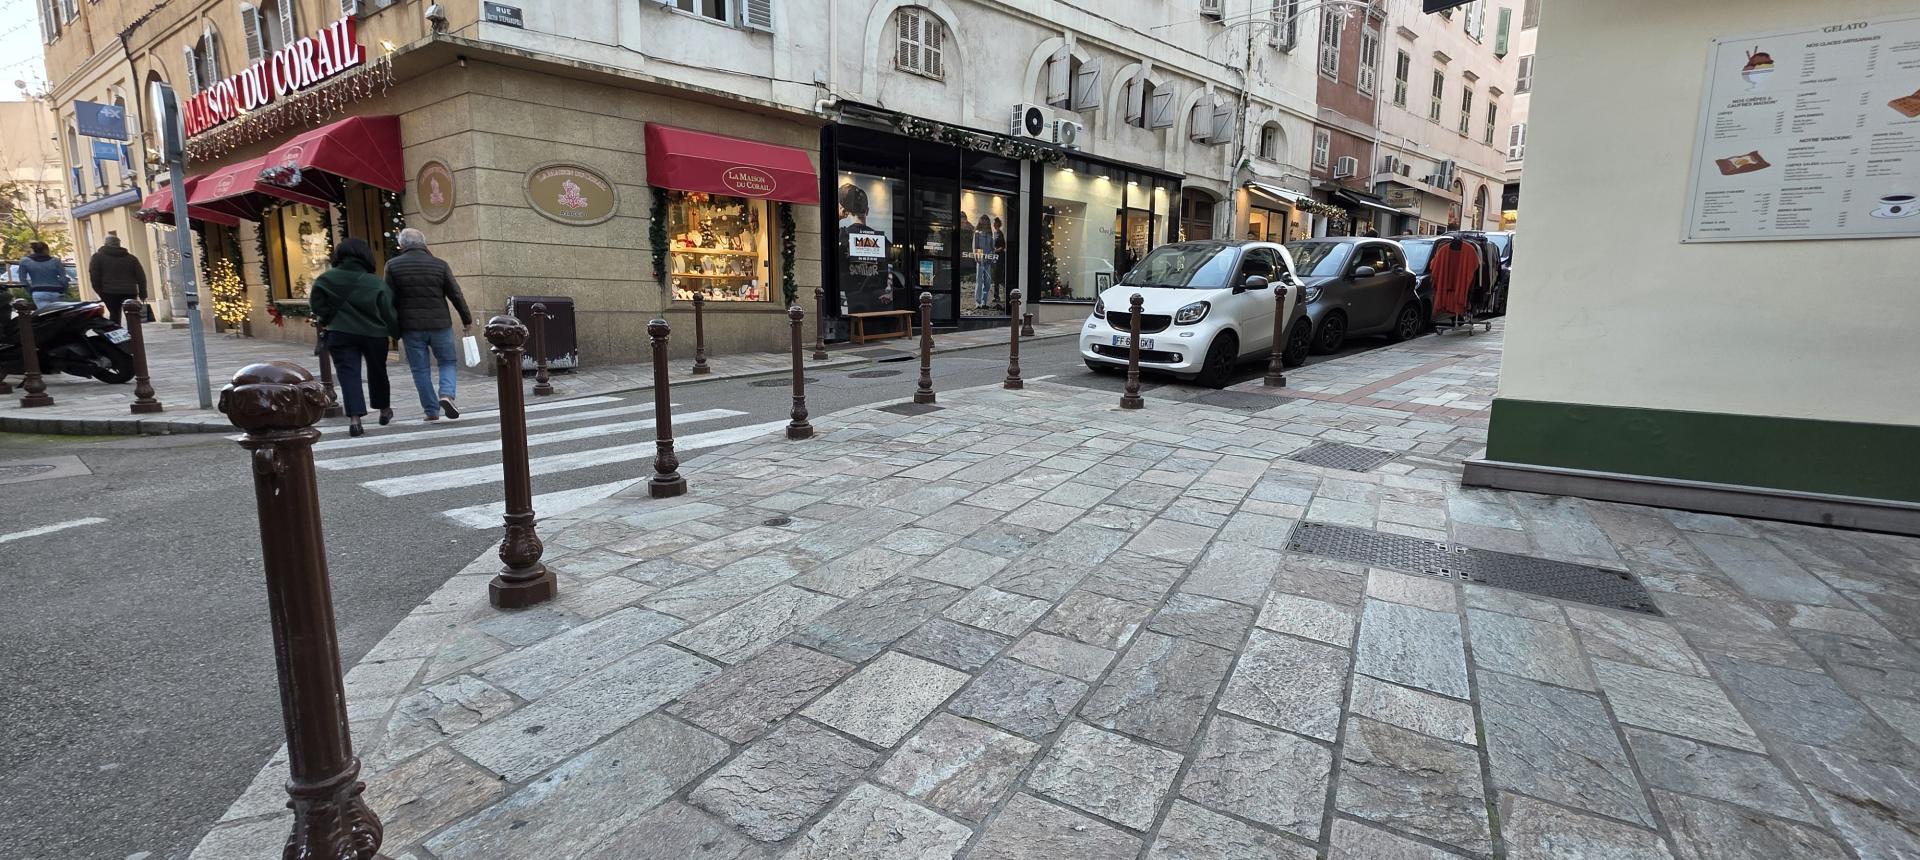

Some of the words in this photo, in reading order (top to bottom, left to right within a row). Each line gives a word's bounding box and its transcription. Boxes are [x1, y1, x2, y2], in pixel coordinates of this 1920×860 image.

[495, 6, 511, 15] RUE
[182, 75, 242, 137] MAISON
[241, 60, 269, 110] DU
[271, 15, 359, 96] CORAIL
[855, 236, 880, 248] MAX
